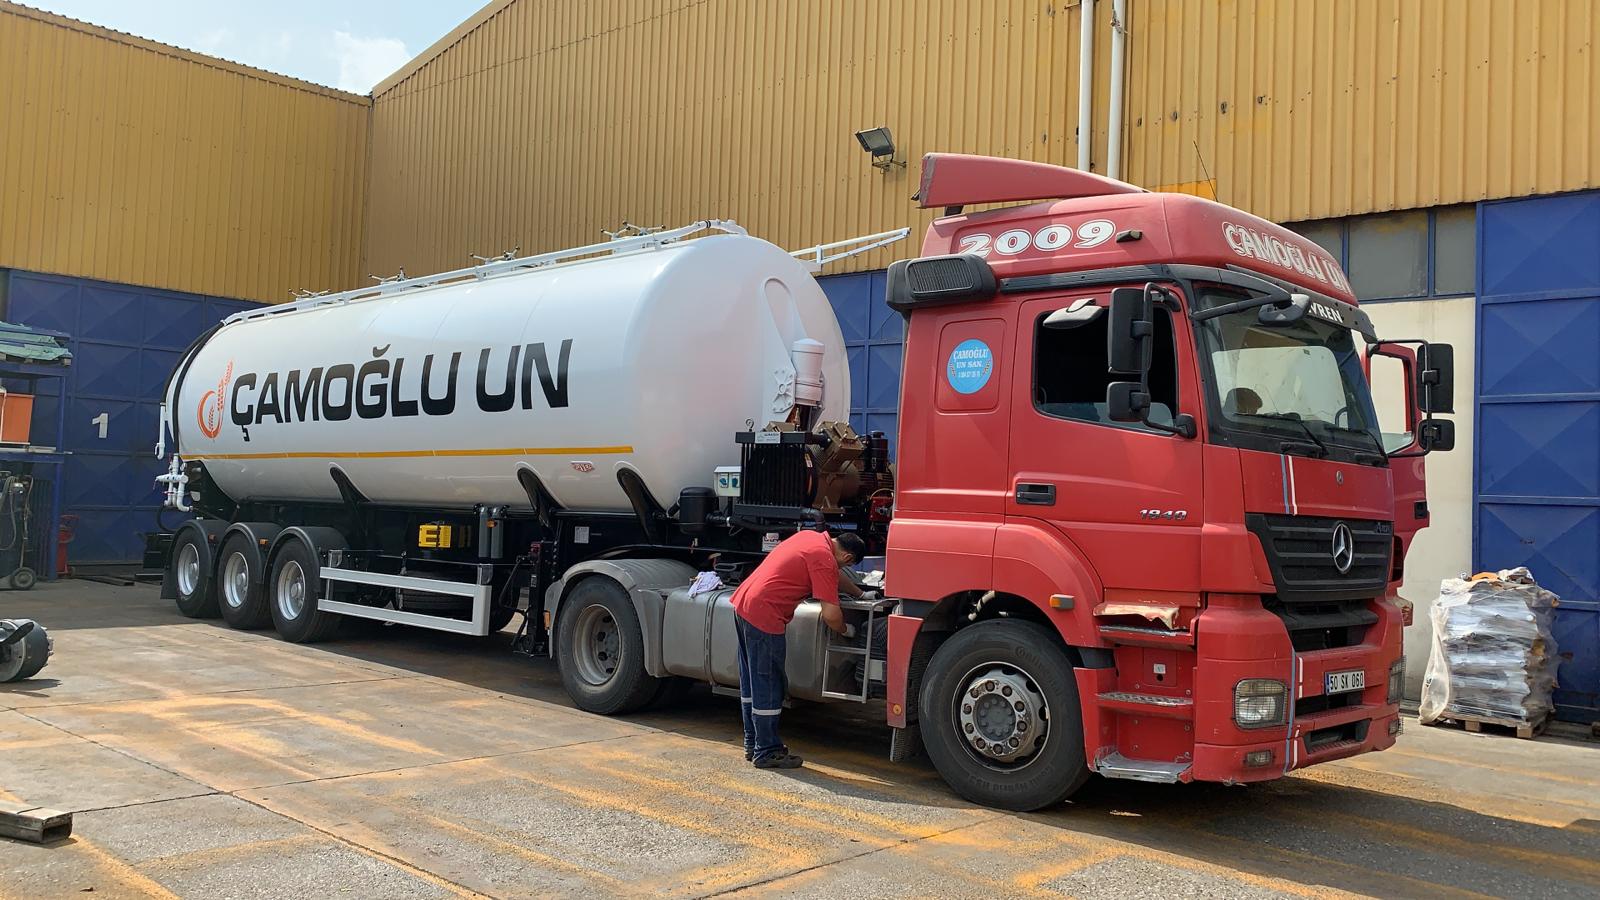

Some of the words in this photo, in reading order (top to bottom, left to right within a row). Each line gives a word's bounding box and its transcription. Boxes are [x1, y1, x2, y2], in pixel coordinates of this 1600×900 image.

[958, 219, 1117, 259] 2009
[1309, 302, 1344, 324] VREN
[956, 361, 967, 369] UN
[230, 343, 461, 442] ÇAMOĞLU
[476, 338, 574, 413] UN
[92, 412, 109, 439] 1
[1330, 675, 1339, 690] 50
[1340, 674, 1349, 689] SK
[1351, 672, 1364, 688] 060
